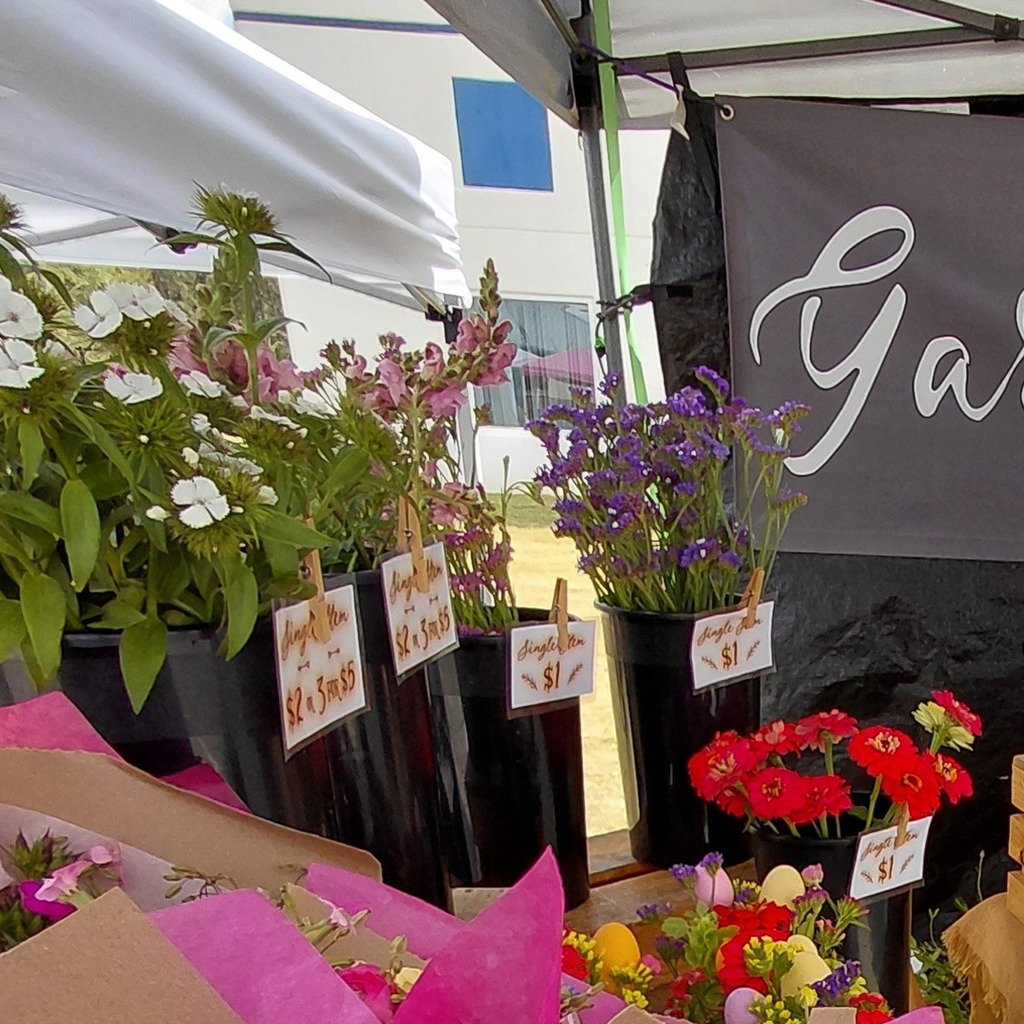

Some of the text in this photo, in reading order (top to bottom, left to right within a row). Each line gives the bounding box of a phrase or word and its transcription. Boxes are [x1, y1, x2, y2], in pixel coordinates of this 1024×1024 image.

[396, 623, 411, 661] $2
[420, 617, 429, 651] 3
[438, 604, 450, 634] $5
[697, 616, 763, 647] Single Sm
[721, 641, 738, 671] $1
[543, 661, 560, 693] $1
[286, 685, 304, 733] $2
[316, 674, 326, 716] 3
[340, 659, 356, 695] $5
[878, 854, 894, 884] $1
